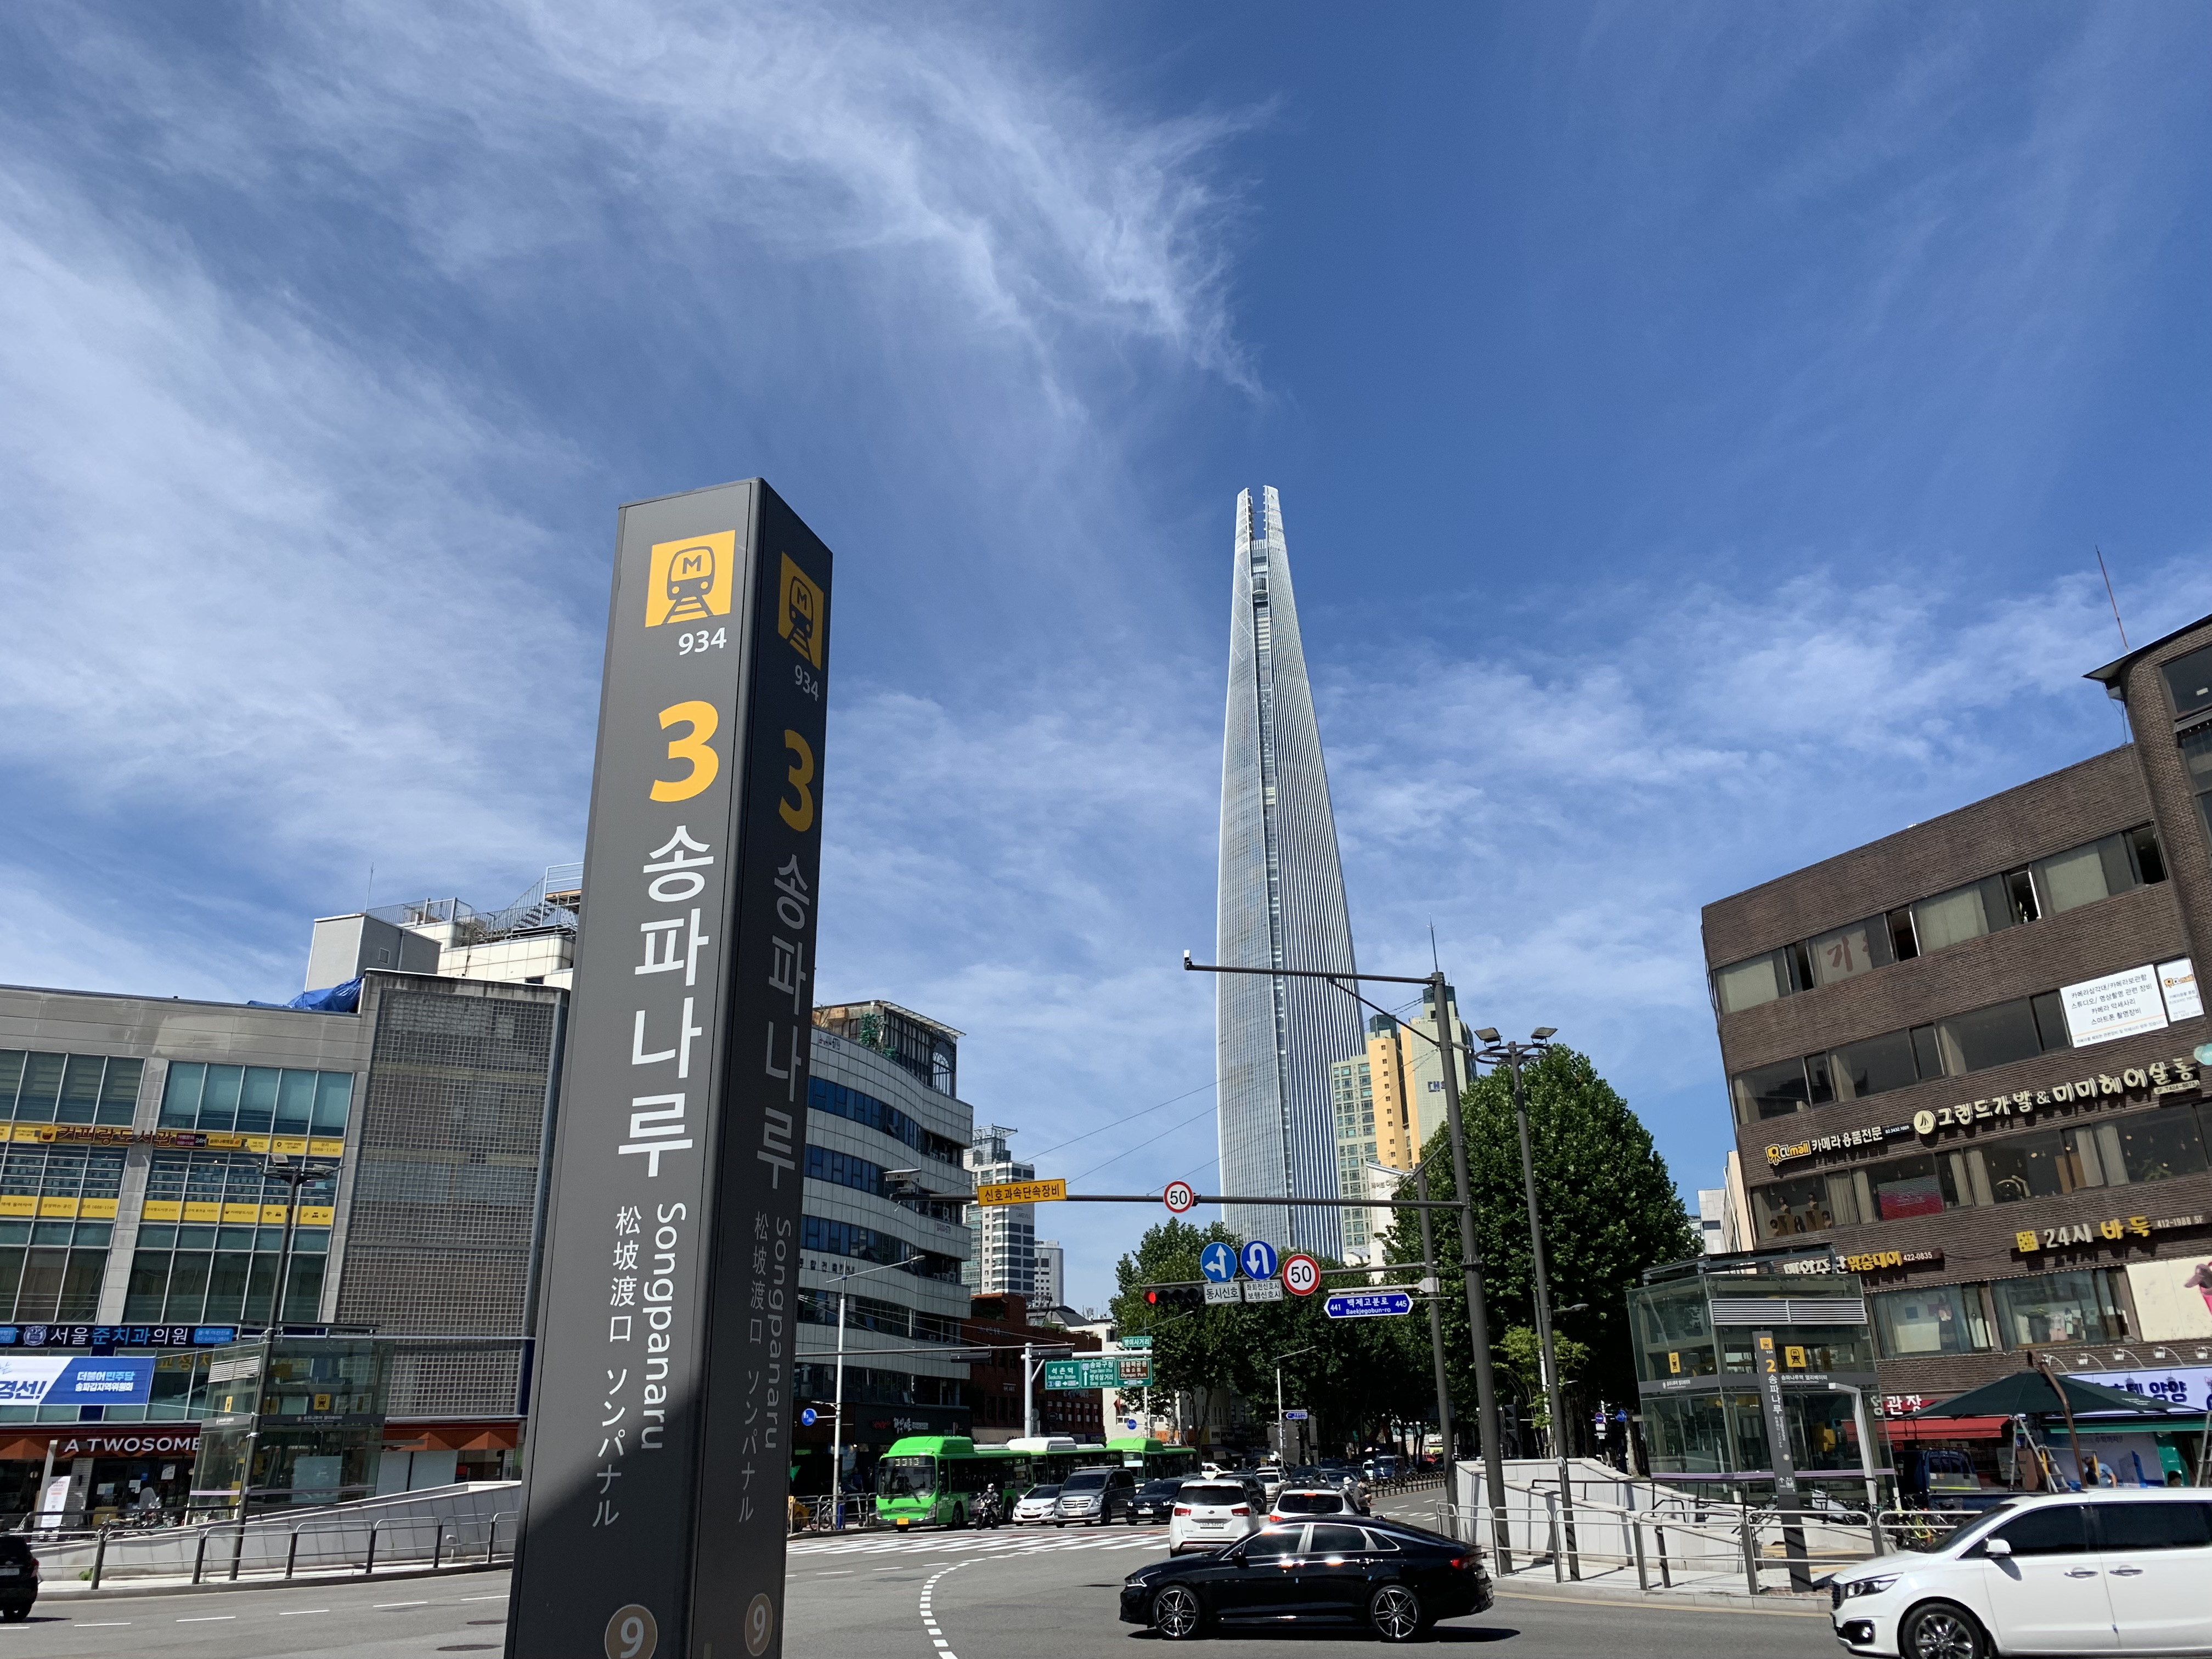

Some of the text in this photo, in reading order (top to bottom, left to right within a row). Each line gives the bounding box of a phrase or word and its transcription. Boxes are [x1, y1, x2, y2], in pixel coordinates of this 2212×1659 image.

[678, 627, 727, 656] 934
[794, 664, 819, 702] 934
[649, 701, 719, 802] 3
[778, 729, 814, 832] 3
[1827, 935, 1868, 972] 기
[618, 825, 714, 1177] 송파나루
[2100, 990, 2124, 1002] 영상촬영
[2125, 987, 2138, 995] 관련
[2140, 983, 2152, 992] 장비
[2091, 998, 2136, 1014] 카메라 악세사리
[2091, 1007, 2142, 1025] 스마트폰 촬영장비
[757, 854, 810, 1189] 송파나루
[2036, 1091, 2051, 1104] &
[59, 1126, 172, 1148] 커피랑도서관
[1812, 1135, 1841, 1152] 카메라
[1842, 1126, 1883, 1147] 용품전문
[985, 1183, 1059, 1202] 신호과속단속장비
[1170, 1190, 1187, 1205] 50
[2044, 1215, 2203, 1248] 24시 바둑 412-1988 5F
[1847, 1250, 1903, 1271] 맞춤대여
[1903, 1252, 1932, 1261] 422-0835
[1291, 1265, 1312, 1283] 50
[1206, 1288, 1239, 1300] 동시신호
[1246, 1281, 1279, 1290] 좌회전신호시
[1248, 1289, 1281, 1299] 보행신호시
[1347, 1297, 1389, 1308] 백제고분로
[50, 1326, 188, 1345] 서울준치과의원
[641, 1202, 686, 1449] Songpanaru
[765, 1217, 792, 1449] Songpanaru
[77, 1371, 135, 1381] 더불어민주당
[592, 1206, 642, 1528] 松坡渡口 ソンパナル
[738, 1211, 768, 1523] 松坡渡口 ソンパナル
[1051, 1367, 1074, 1375] 석촌역
[1765, 1359, 1776, 1372] 2
[75, 1382, 133, 1392] 송파갑지역위원회
[1768, 1374, 1782, 1414] 송파나루
[64, 1437, 201, 1452] A TWOSOME
[753, 1605, 766, 1645] 9
[619, 1616, 645, 1657] 9
